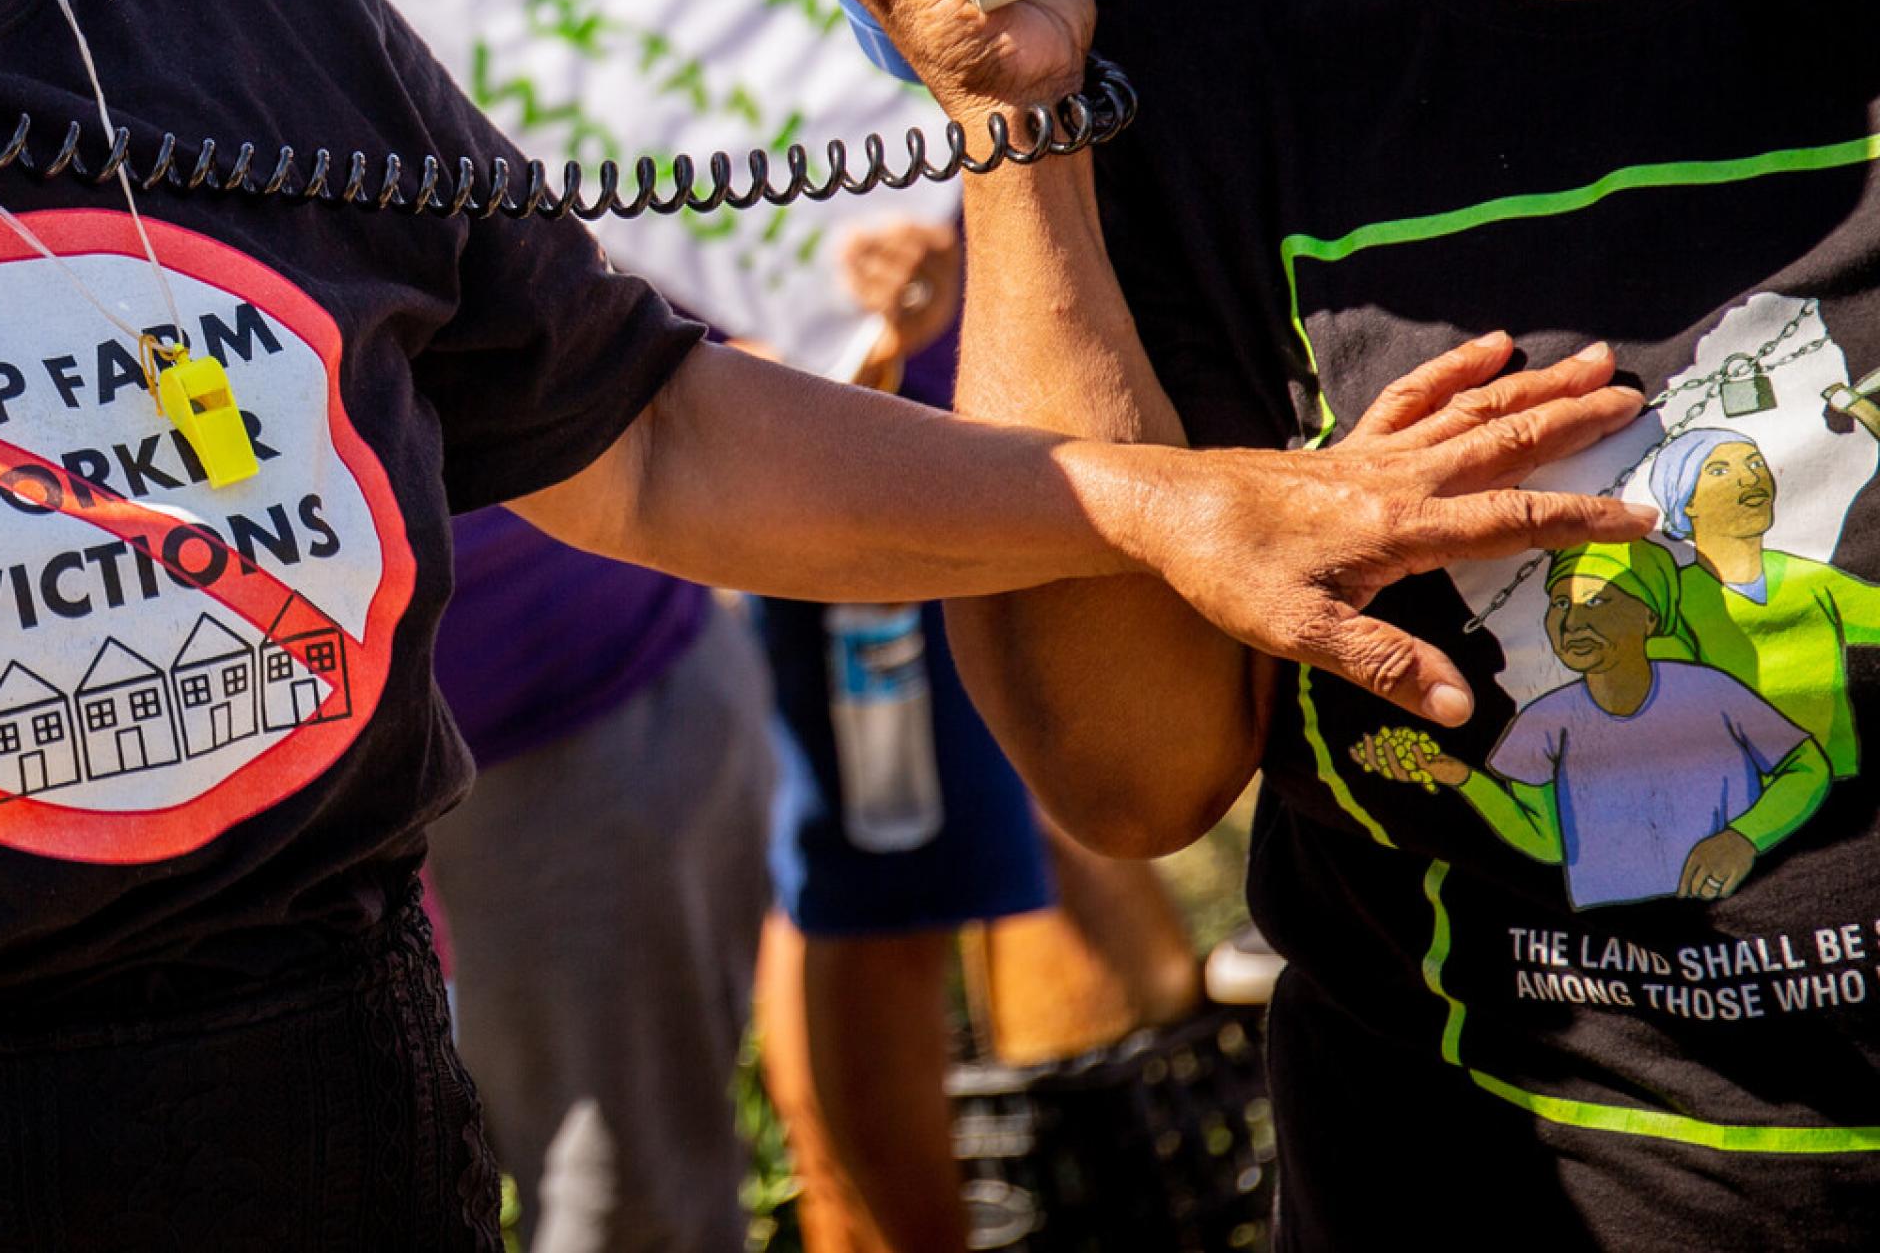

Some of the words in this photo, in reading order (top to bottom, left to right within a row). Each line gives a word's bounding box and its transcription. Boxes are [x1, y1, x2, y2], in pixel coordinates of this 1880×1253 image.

[1508, 927, 1570, 967] THE
[1580, 934, 1672, 976] LAND
[1677, 934, 1806, 982] SHALL
[1814, 923, 1866, 965] BE
[1516, 969, 1636, 1007] AMONG
[1641, 983, 1765, 1021] THOSE
[1772, 969, 1866, 1013] WHO
